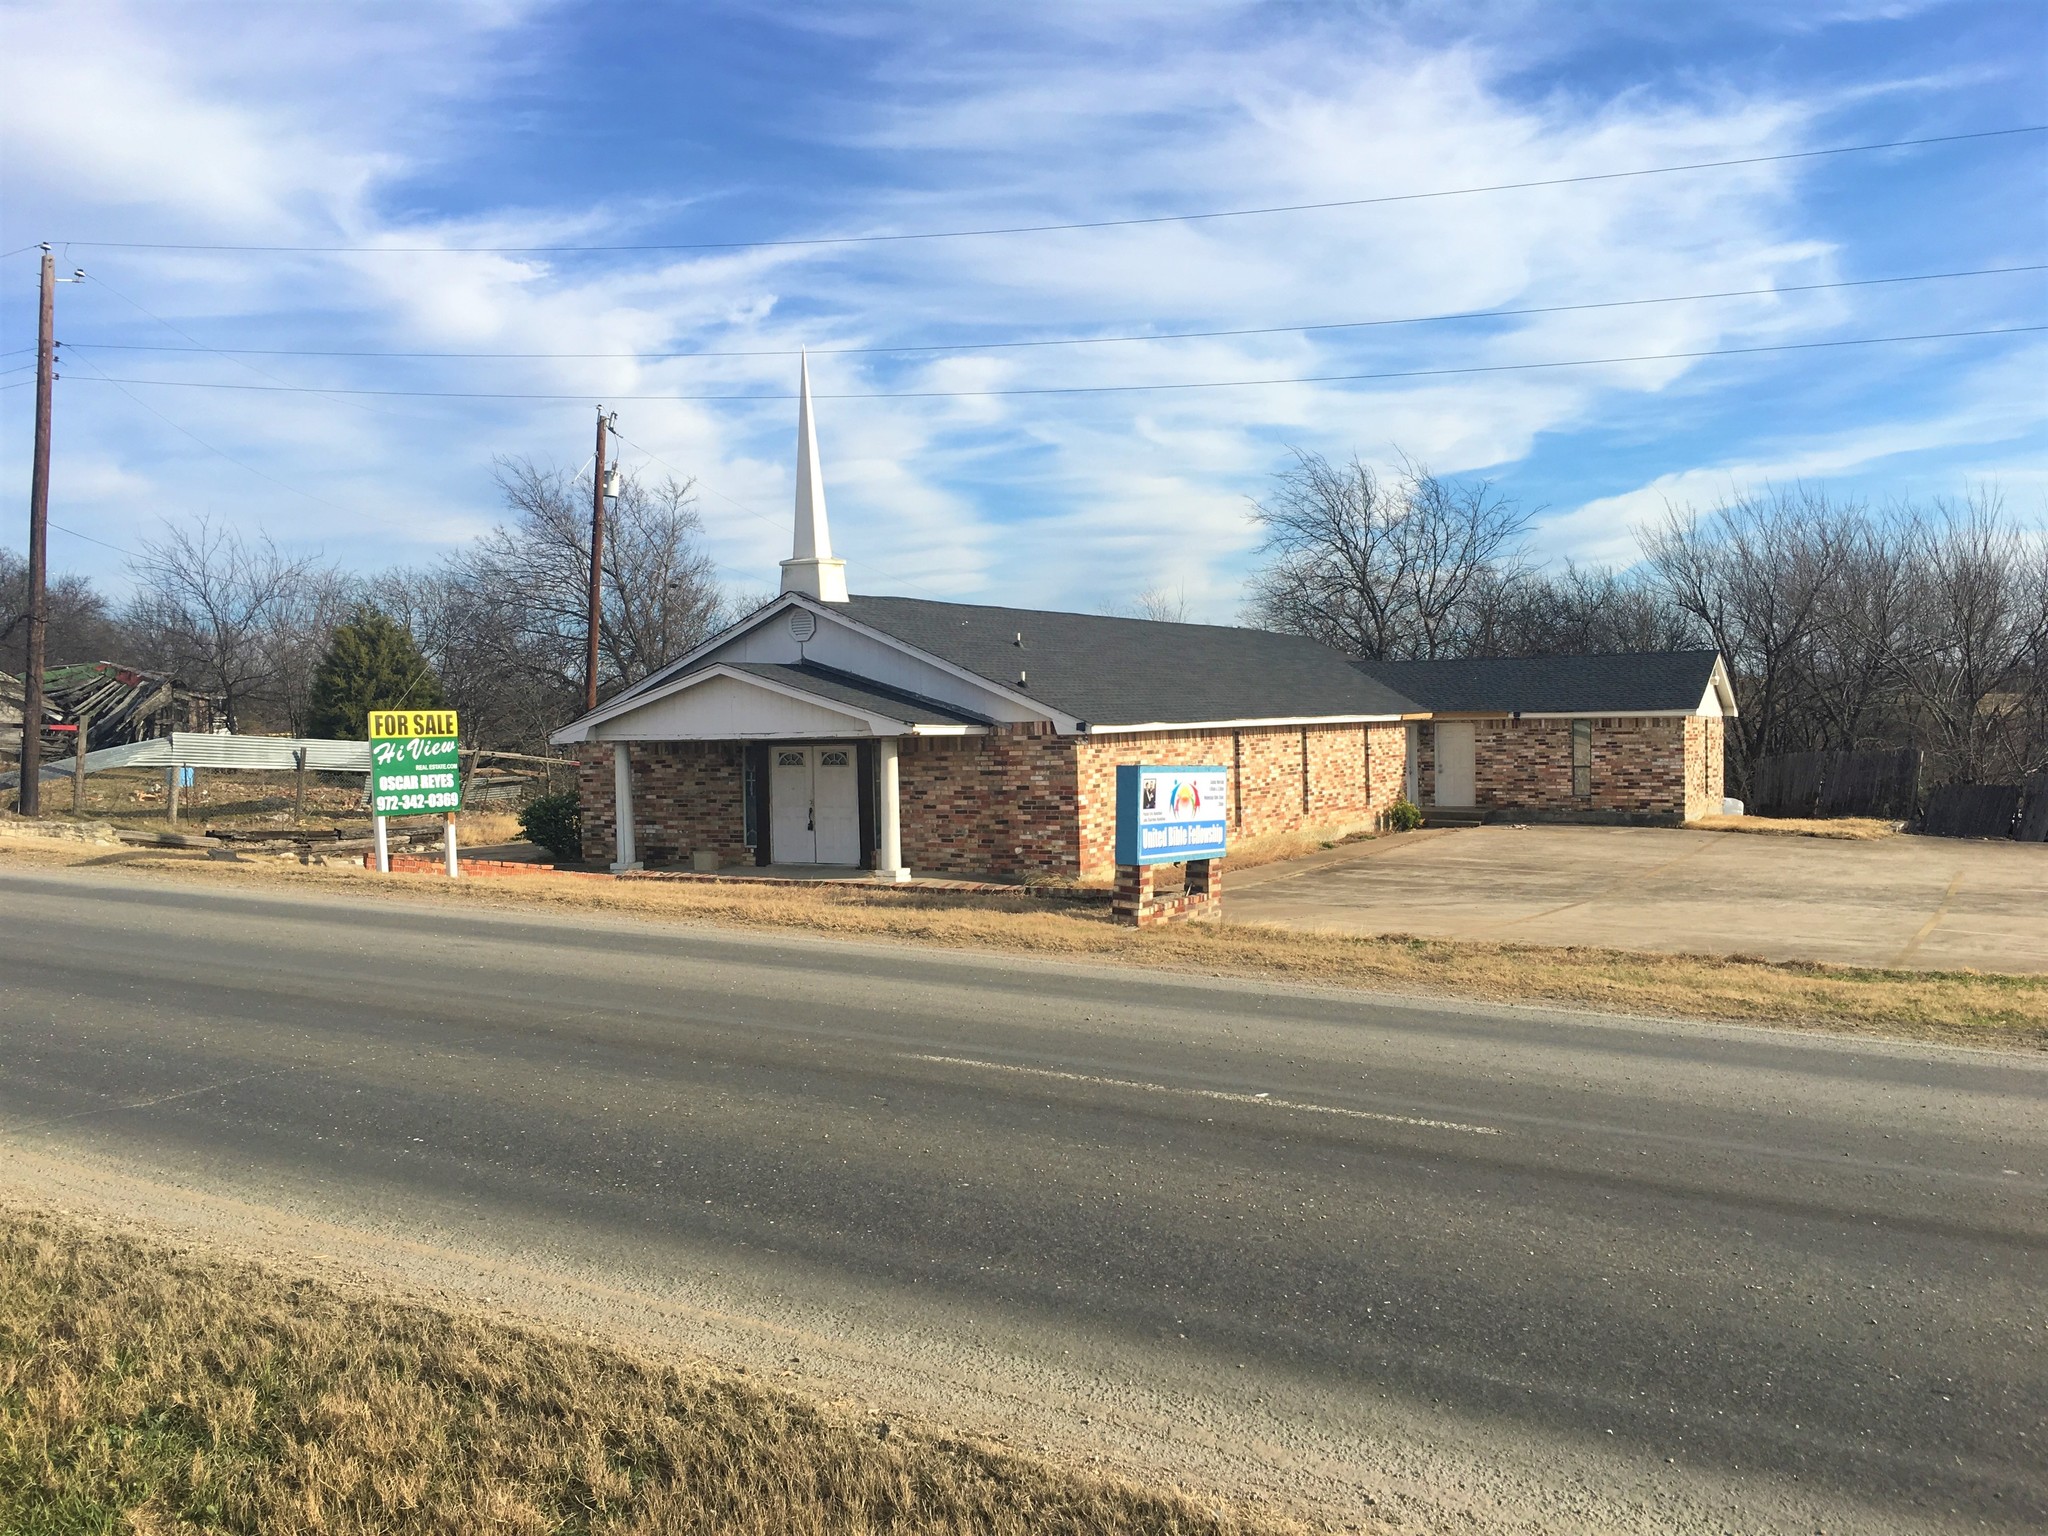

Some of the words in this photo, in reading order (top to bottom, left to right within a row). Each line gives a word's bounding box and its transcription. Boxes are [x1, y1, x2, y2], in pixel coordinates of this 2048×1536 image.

[374, 714, 408, 735] FOR
[413, 713, 454, 735] SALE
[373, 742, 405, 765] Hi
[406, 738, 456, 760] View
[379, 775, 418, 791] OSCAR
[420, 773, 454, 789] REYES
[376, 792, 459, 811] 972-342-0369
[1142, 826, 1167, 849] United
[1168, 825, 1187, 847] Bible
[1188, 824, 1223, 845] Fellowship
